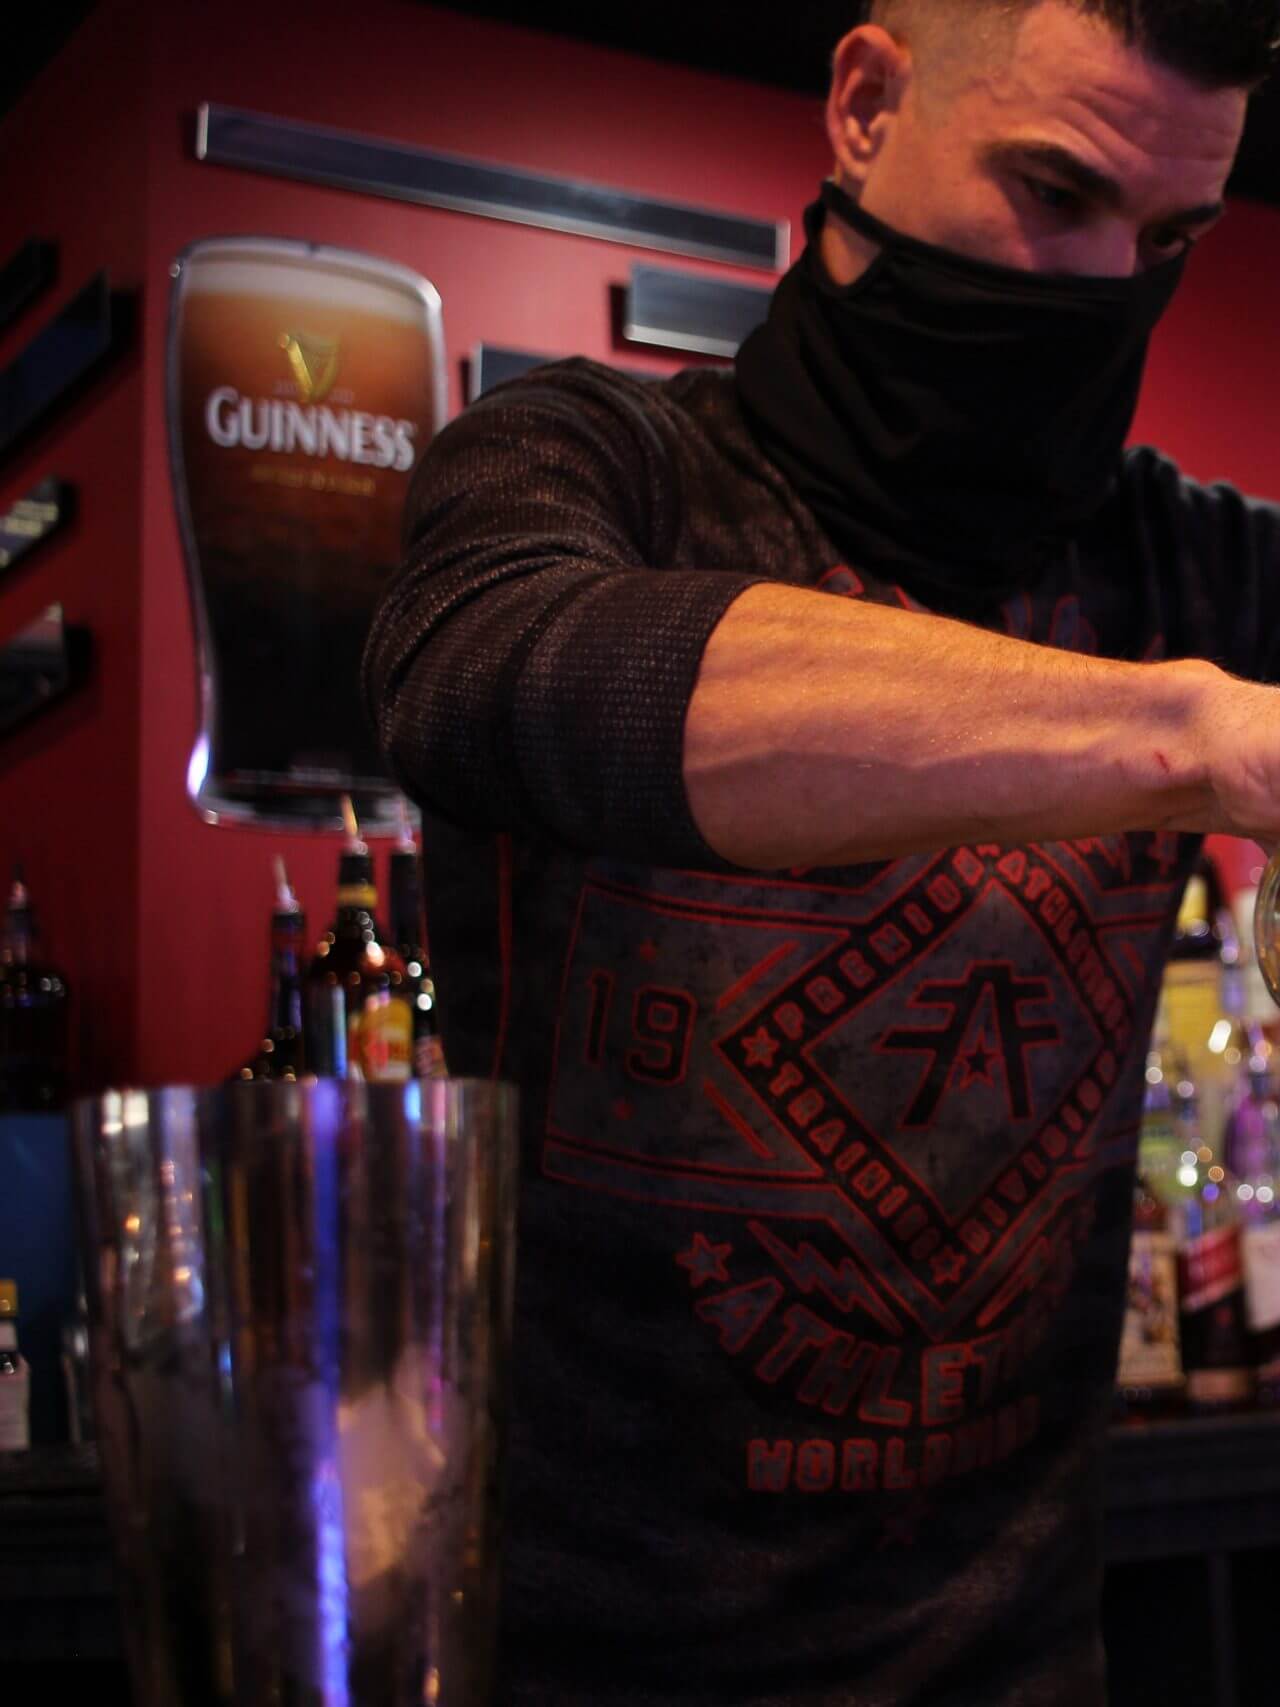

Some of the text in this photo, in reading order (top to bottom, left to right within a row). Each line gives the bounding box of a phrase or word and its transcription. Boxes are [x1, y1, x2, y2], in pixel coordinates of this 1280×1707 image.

[207, 386, 416, 472] GUINNESS
[772, 845, 985, 1041] PREMIUM
[586, 968, 697, 1088] 19
[768, 1060, 944, 1261] TRAINING
